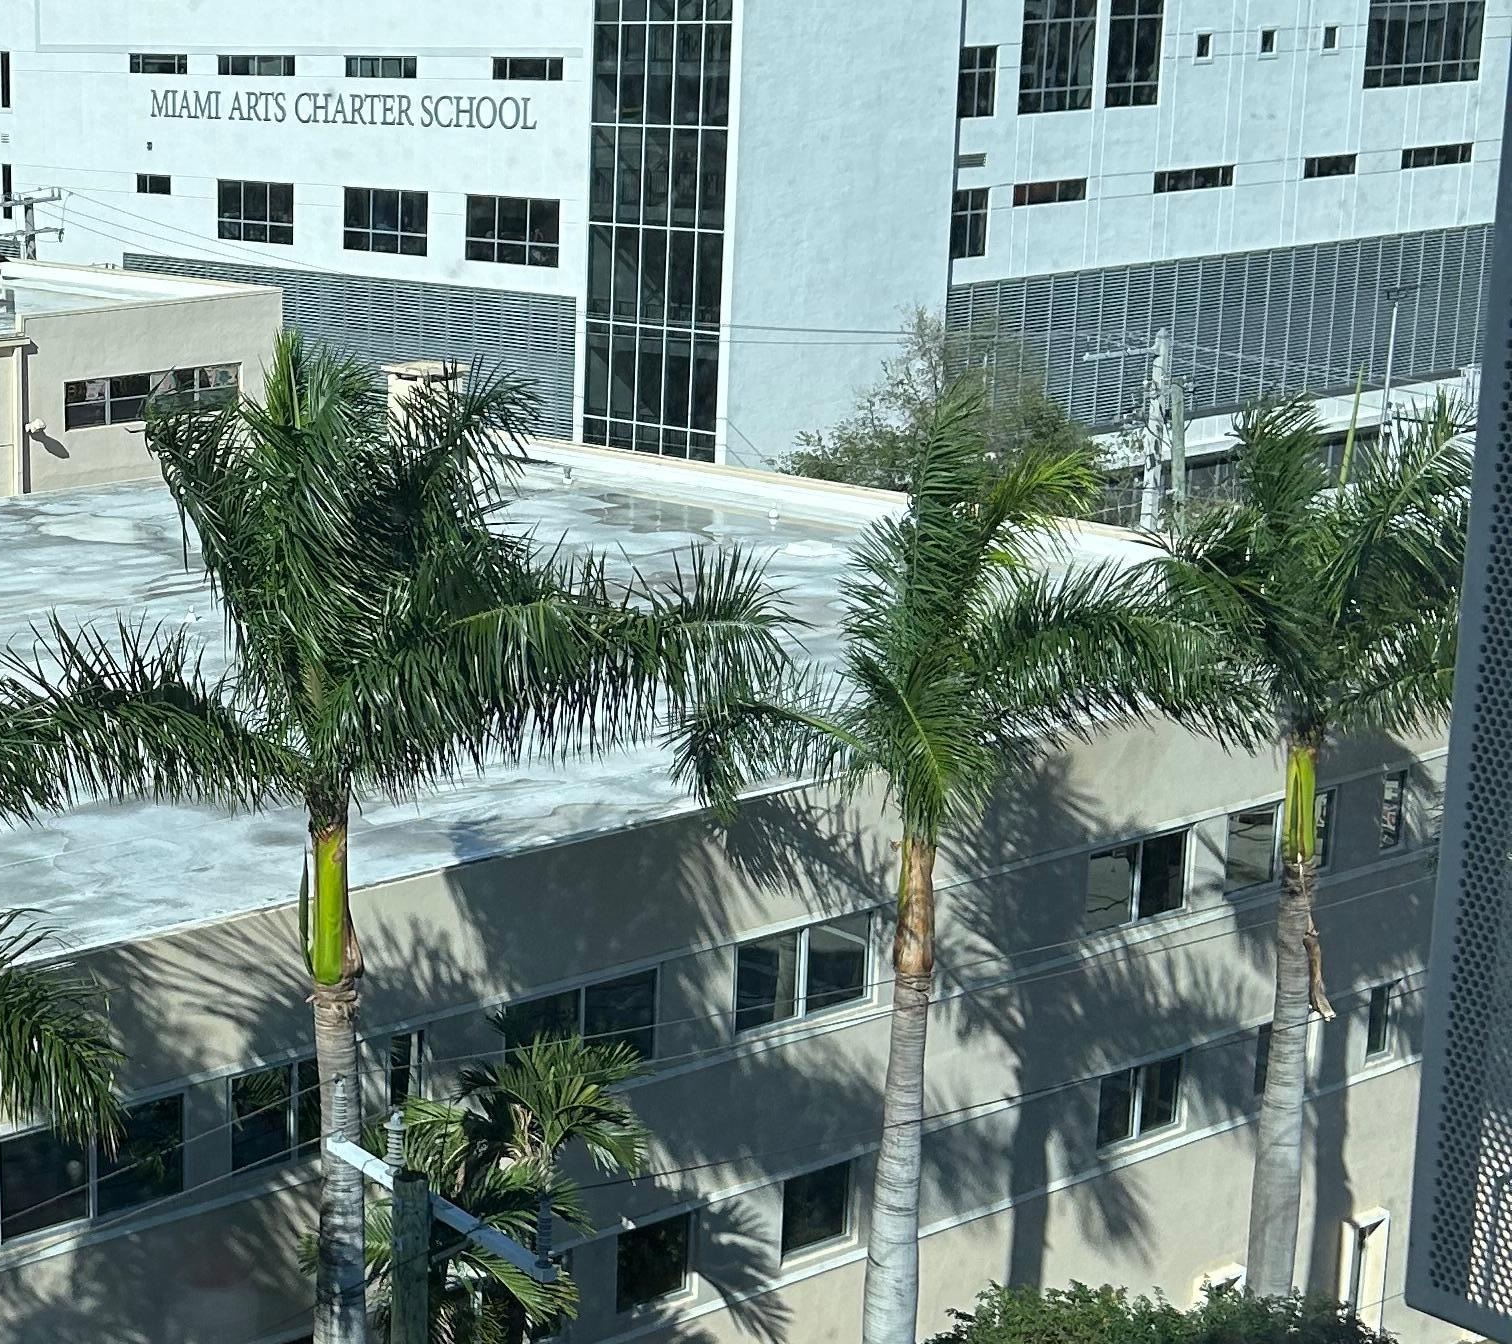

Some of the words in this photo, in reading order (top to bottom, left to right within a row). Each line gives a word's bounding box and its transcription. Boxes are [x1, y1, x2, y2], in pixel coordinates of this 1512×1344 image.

[150, 89, 222, 120] MIAMI
[228, 91, 286, 123] ARTS
[295, 93, 414, 127] CHARTER
[420, 96, 537, 130] SCHOOL
